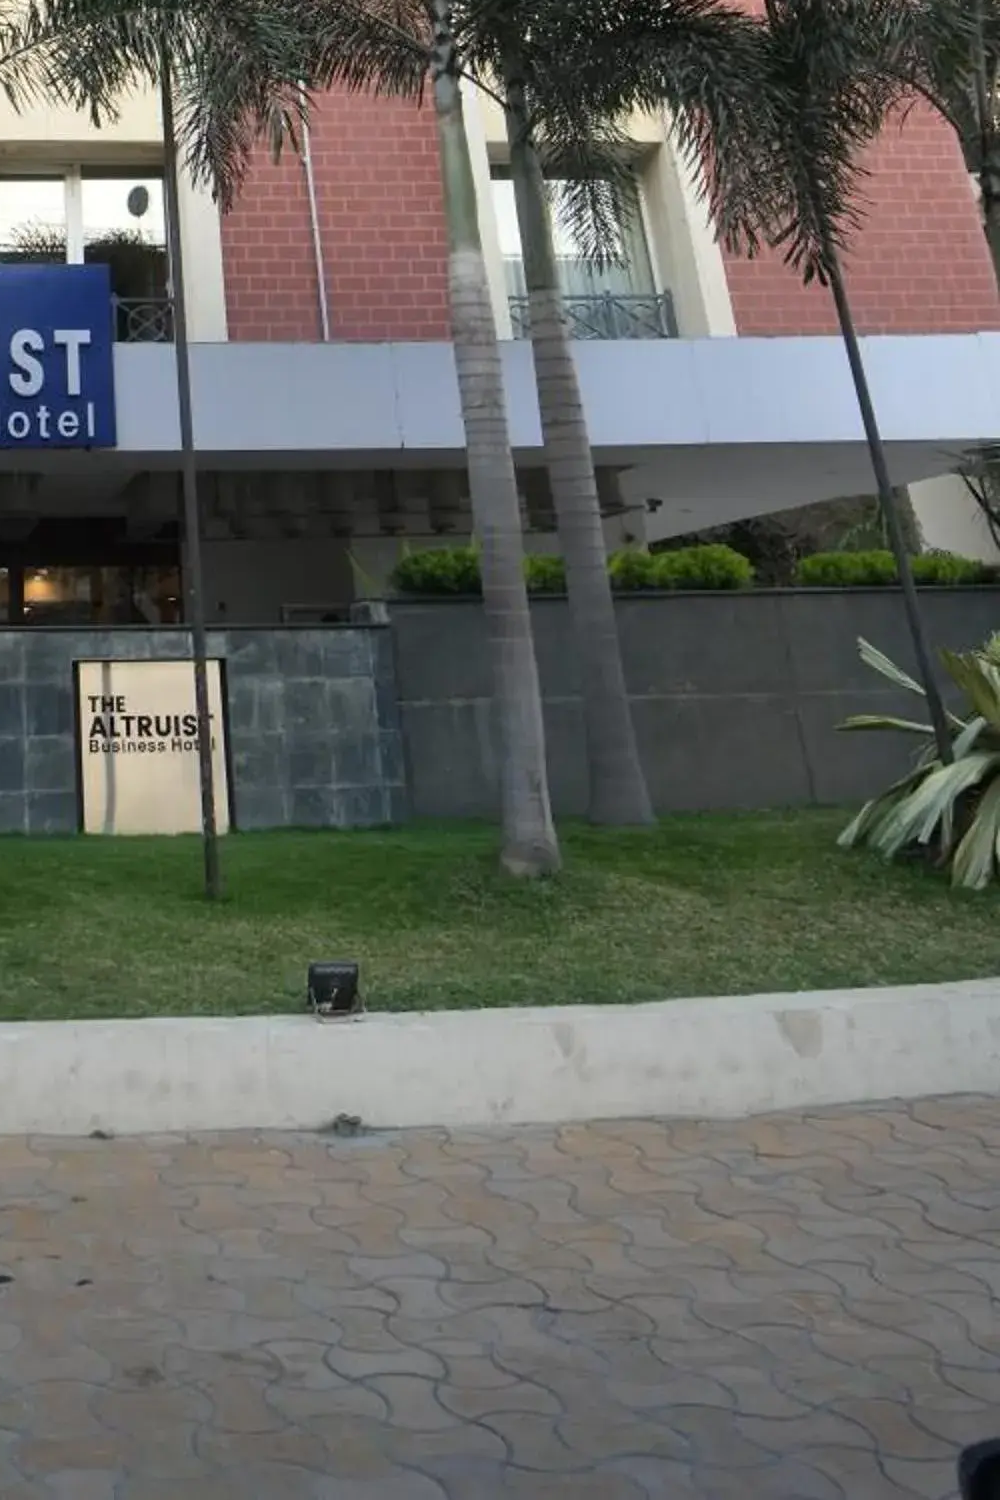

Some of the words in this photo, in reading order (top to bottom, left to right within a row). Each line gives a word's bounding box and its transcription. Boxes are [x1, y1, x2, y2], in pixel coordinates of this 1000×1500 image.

[88, 696, 126, 712] THE
[89, 715, 213, 737] ALTRUIS
[89, 740, 167, 753] Business
[171, 737, 216, 752] Hotl
